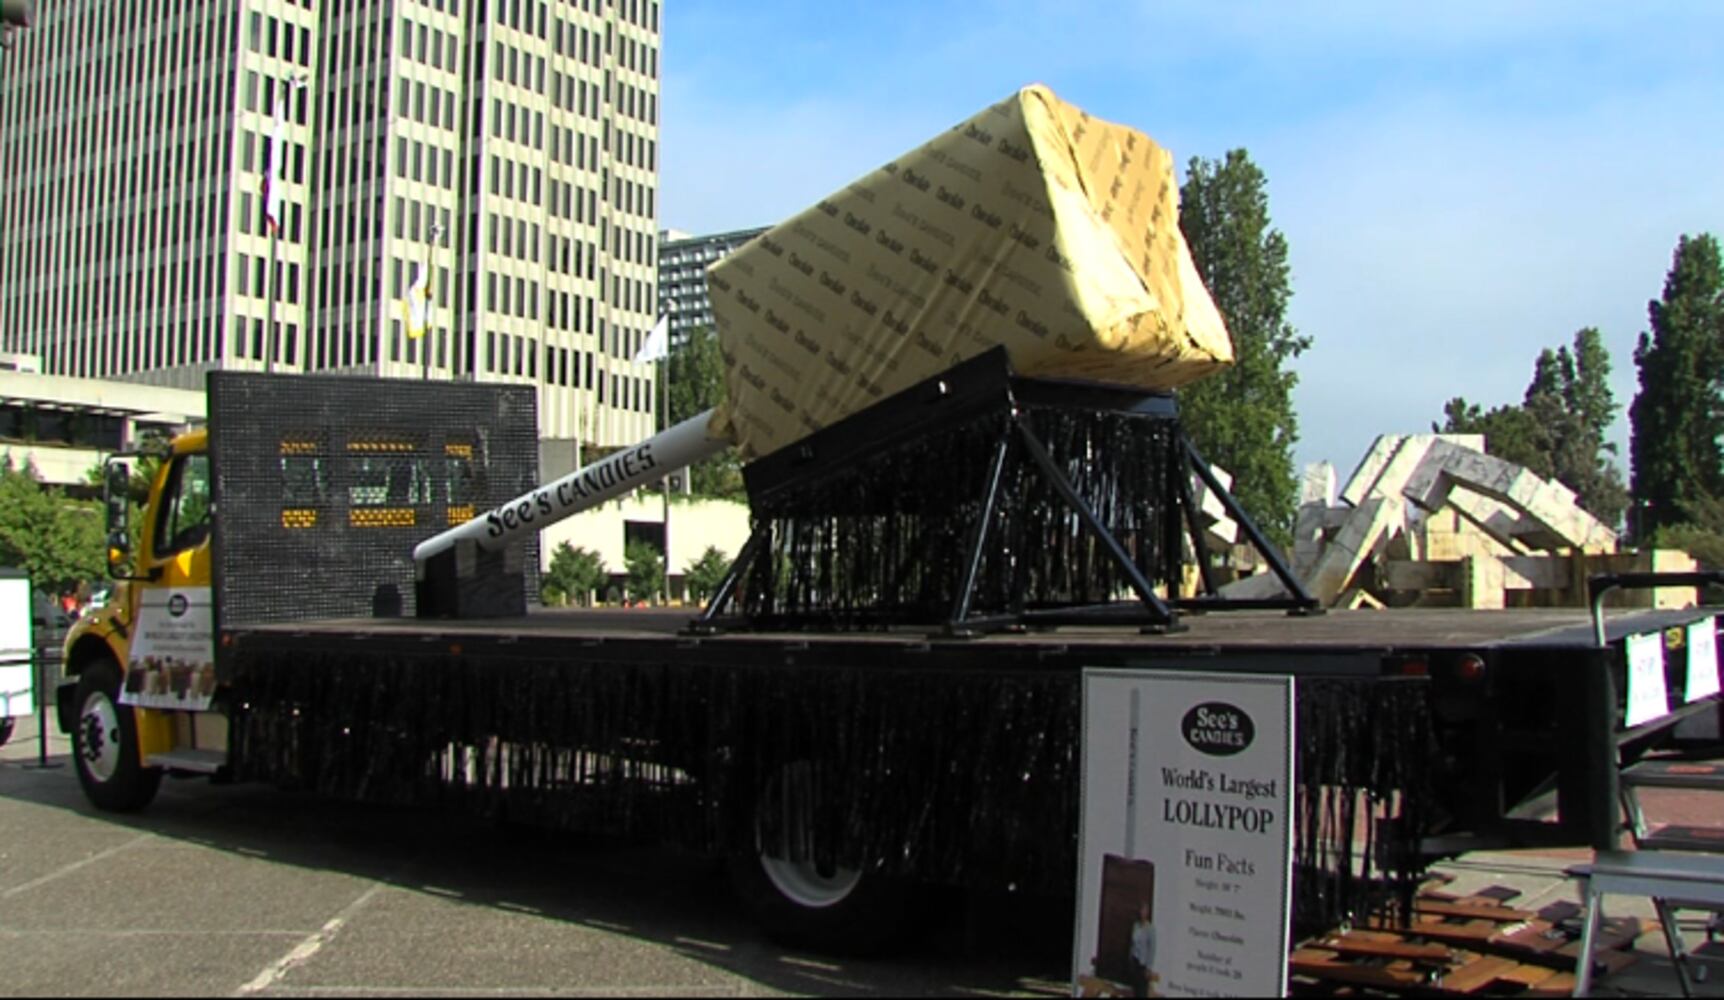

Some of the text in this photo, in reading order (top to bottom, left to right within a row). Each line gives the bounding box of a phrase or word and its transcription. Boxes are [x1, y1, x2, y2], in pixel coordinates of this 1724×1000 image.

[486, 445, 656, 538] See's CANDIES
[1196, 706, 1239, 730] See's
[1161, 766, 1277, 800] World's Largest
[1163, 798, 1275, 835] LOLLYPOP
[1185, 848, 1256, 876] Fun Facts
